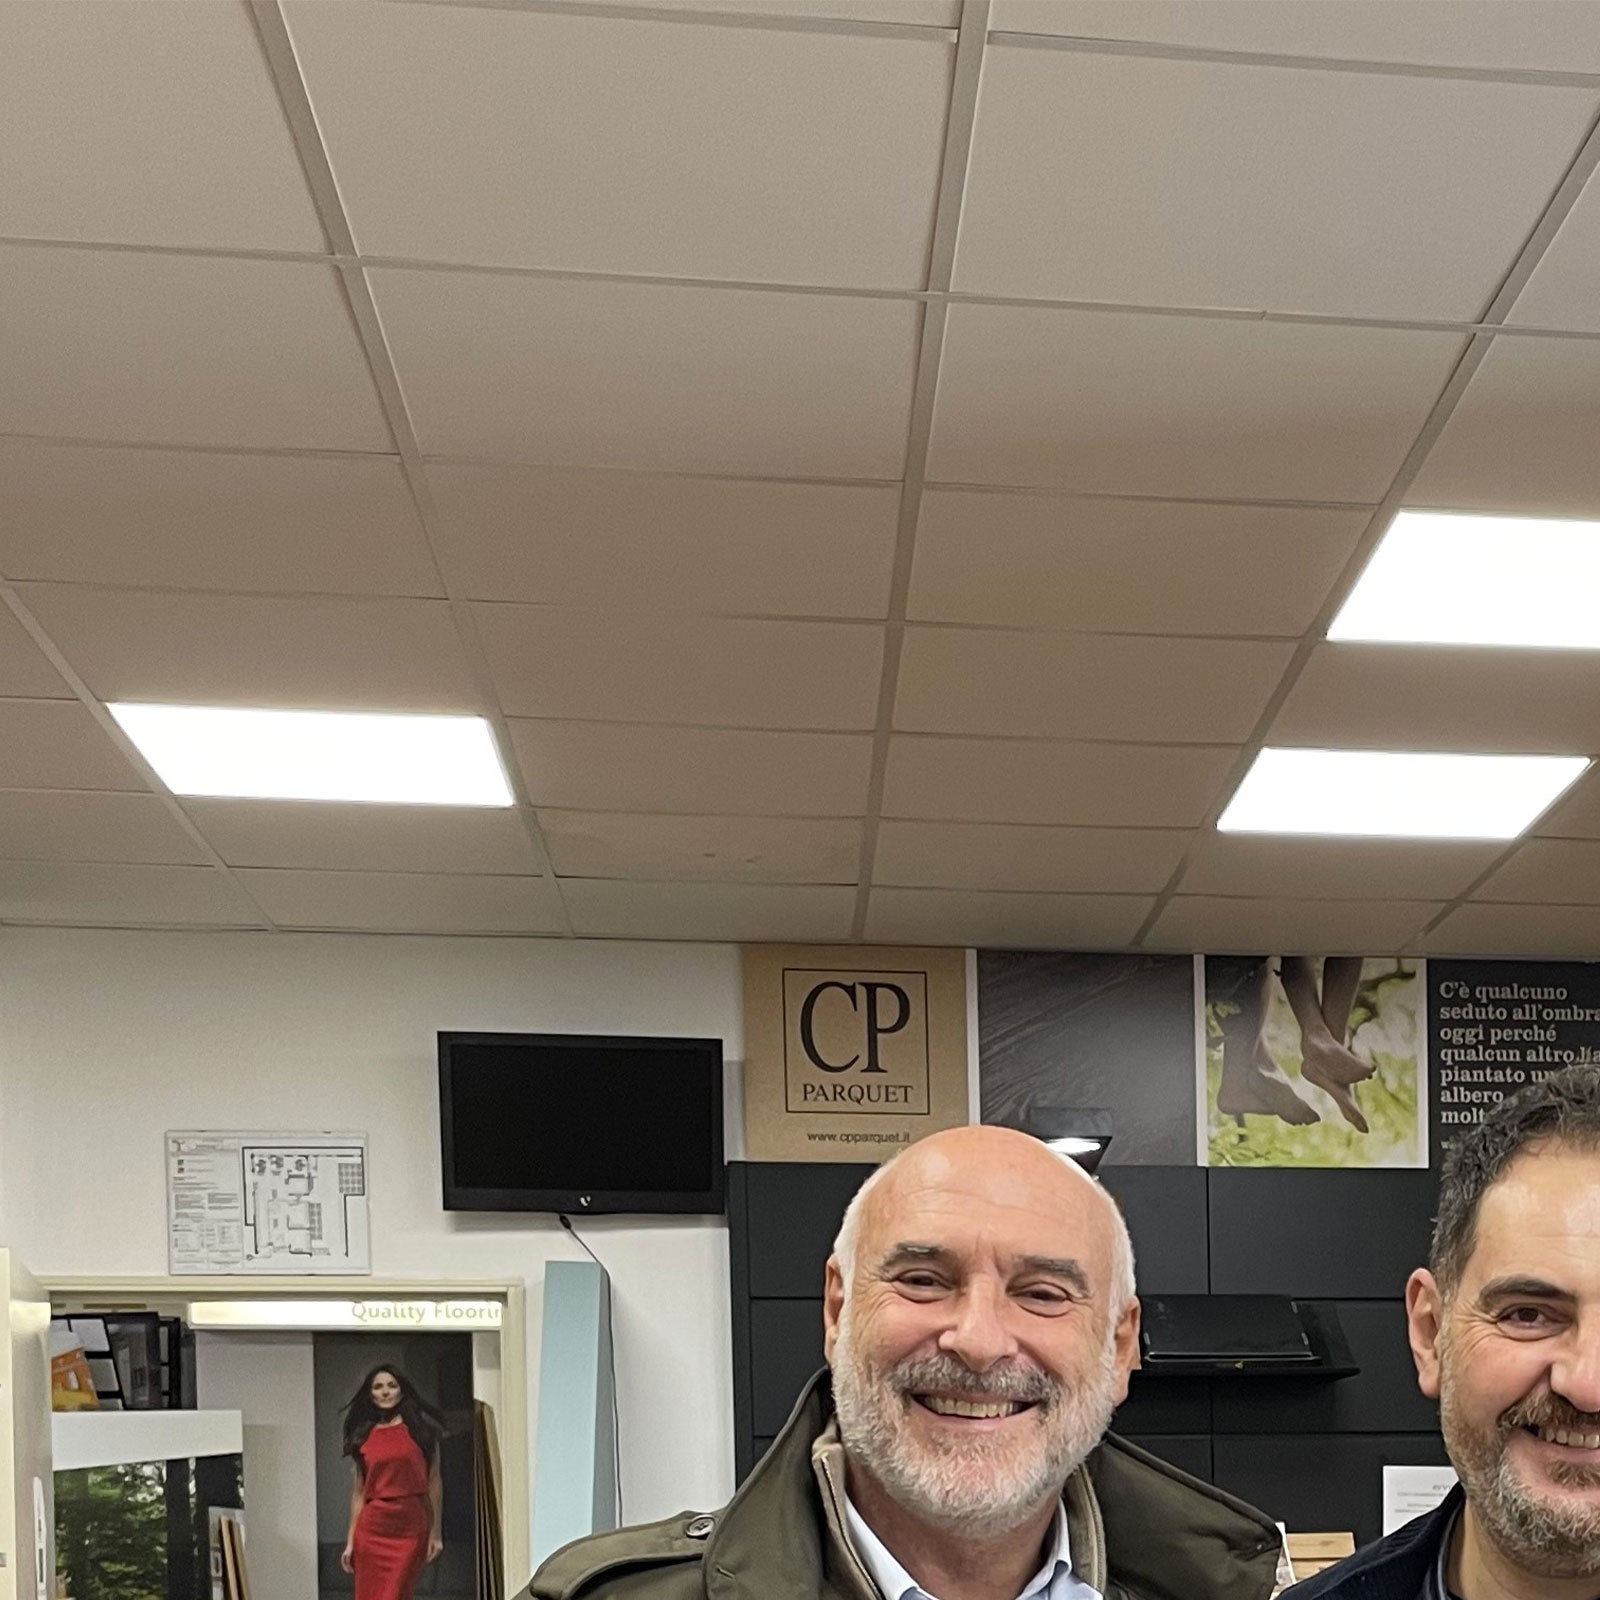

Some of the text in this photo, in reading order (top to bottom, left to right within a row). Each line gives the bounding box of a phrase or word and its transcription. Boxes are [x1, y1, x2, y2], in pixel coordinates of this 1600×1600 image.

[1475, 983, 1568, 1003] qualcuno
[1439, 1003, 1508, 1020] seduto
[801, 981, 911, 1073] CP
[1439, 1024, 1557, 1045] oggi perché
[1439, 1046, 1521, 1065] qualcun
[1526, 1047, 1574, 1063] altro
[1439, 1066, 1526, 1085] piantato
[802, 1083, 914, 1106] PARQUET
[1439, 1087, 1504, 1103] albero
[807, 1132, 911, 1145] www.cpparquet.it
[352, 1304, 426, 1323] Quality
